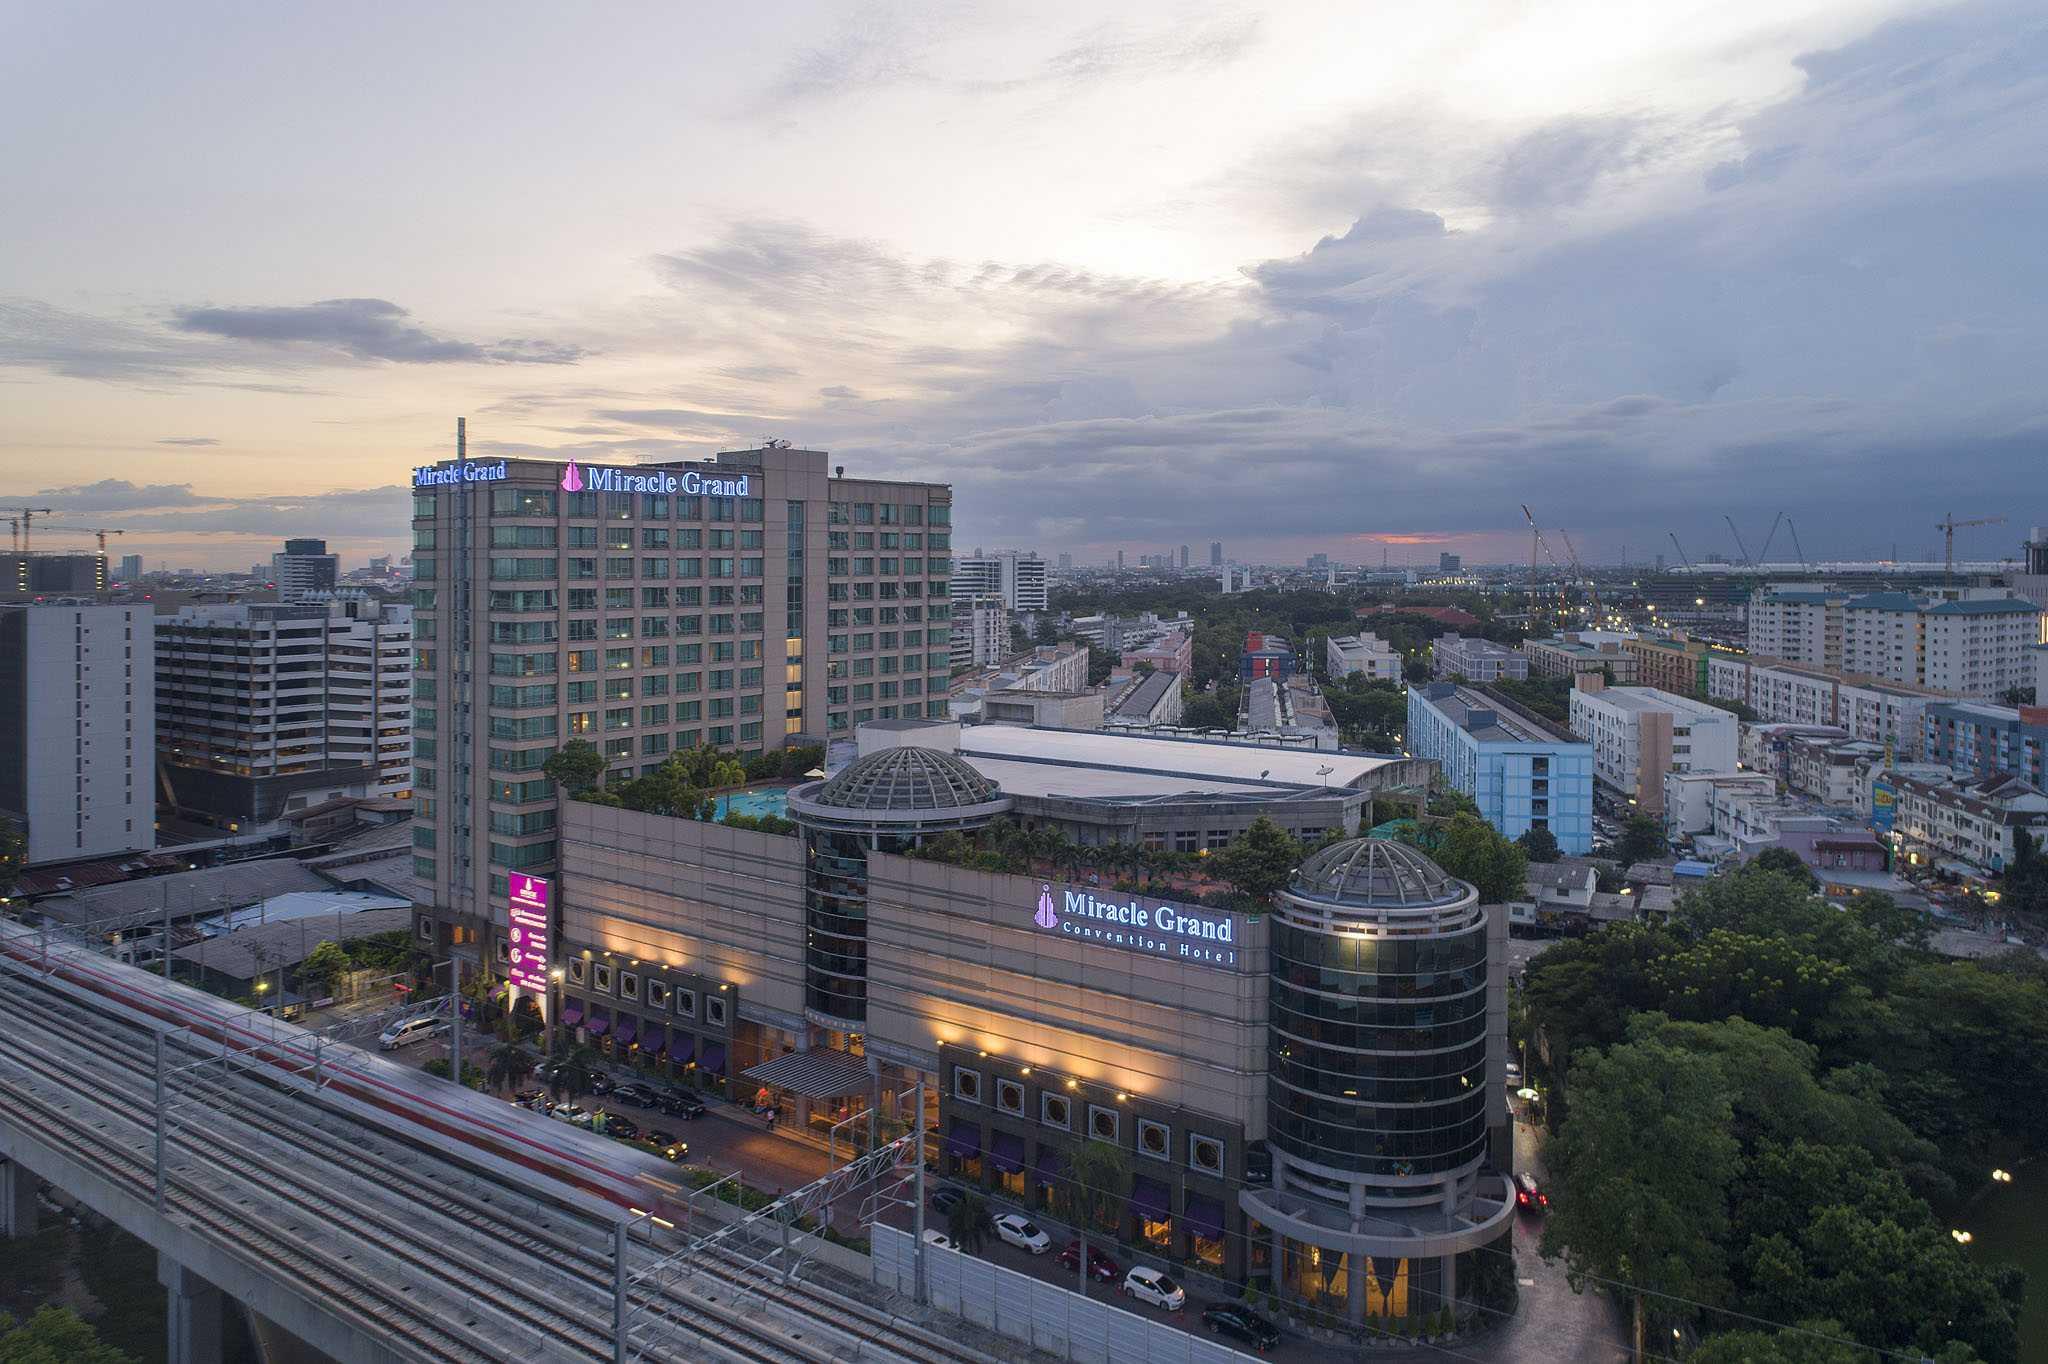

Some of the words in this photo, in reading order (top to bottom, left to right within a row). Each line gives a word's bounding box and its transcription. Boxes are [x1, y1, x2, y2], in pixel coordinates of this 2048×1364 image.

[415, 465, 460, 486] Miracle
[464, 461, 506, 481] Grand
[587, 467, 677, 493] Miracle
[681, 472, 749, 496] Grand
[1064, 891, 1148, 926] Miracle
[1155, 906, 1233, 942] Grand
[1063, 921, 1166, 951] Convention
[1179, 943, 1234, 963] Hotel
